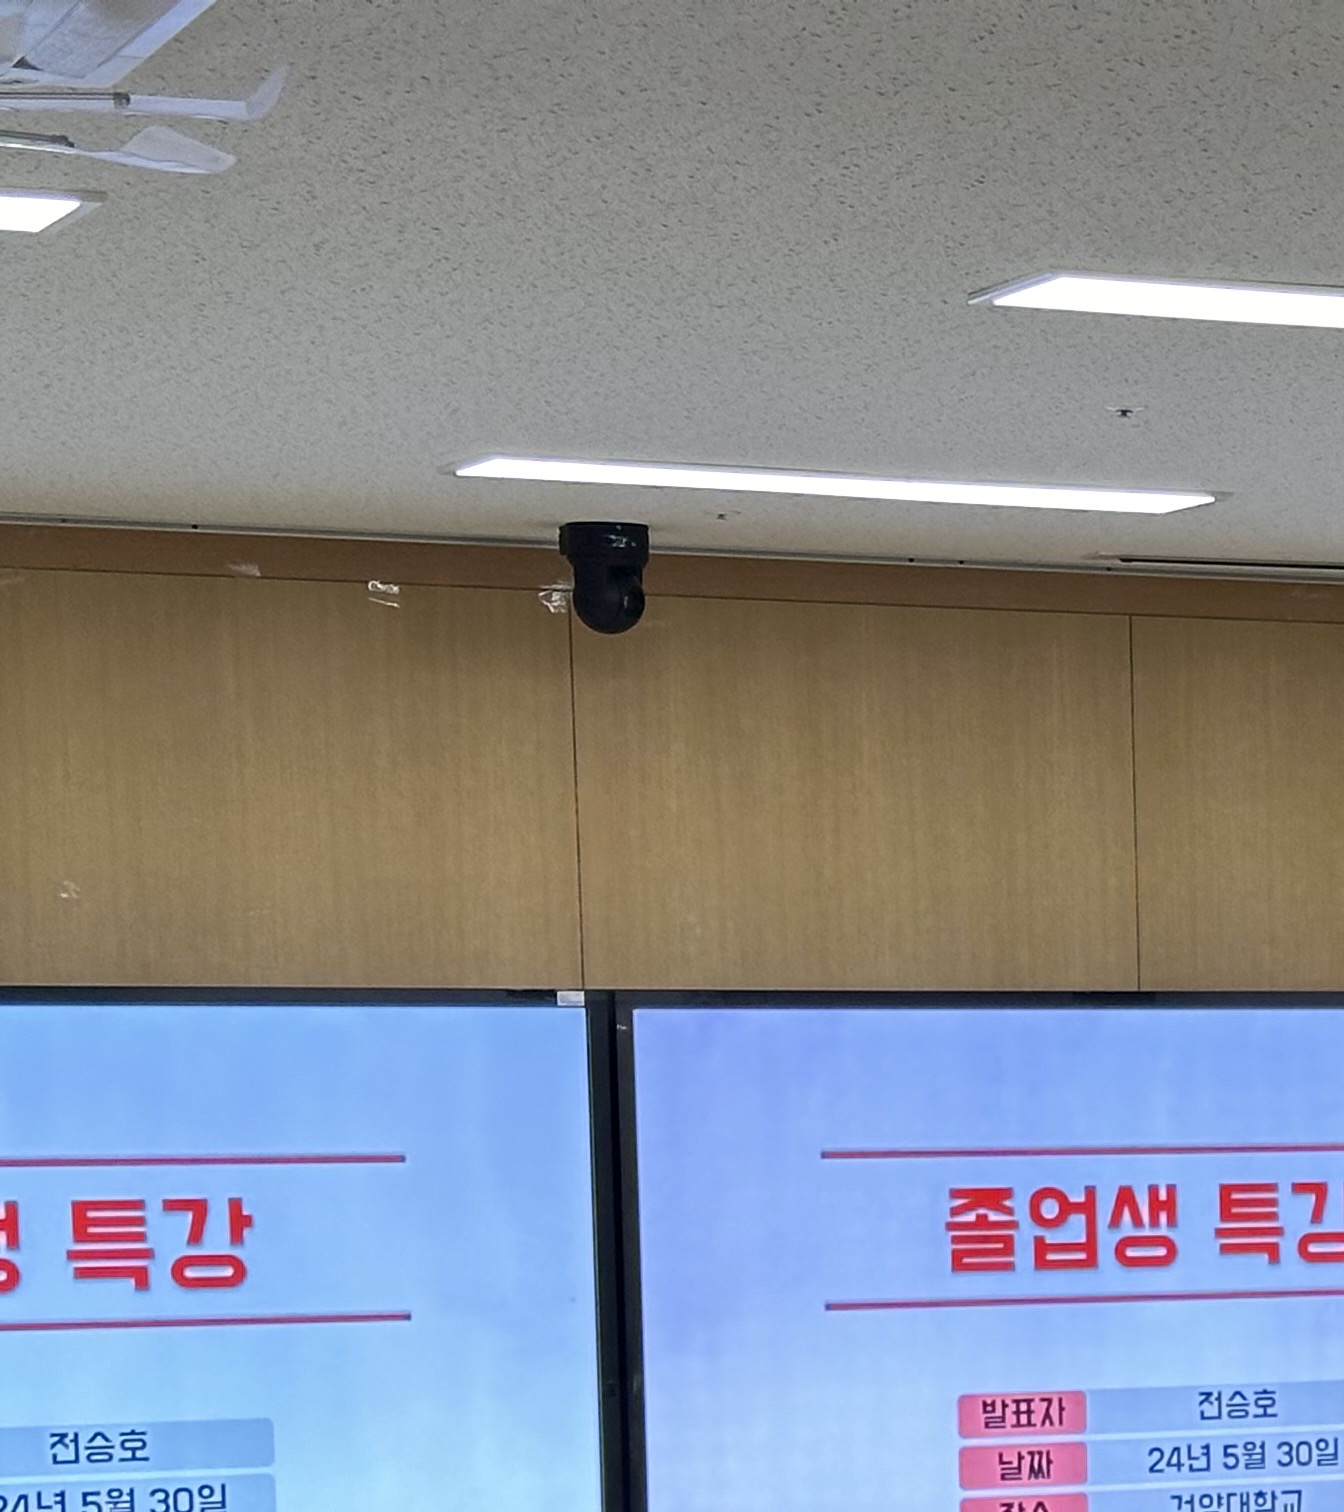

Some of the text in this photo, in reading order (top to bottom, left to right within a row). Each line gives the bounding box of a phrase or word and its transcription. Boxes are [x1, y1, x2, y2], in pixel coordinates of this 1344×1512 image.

[66, 1198, 254, 1290] 특강
[945, 1184, 1178, 1273] 졸업생
[982, 1397, 1066, 1430] 발표자
[1198, 1389, 1279, 1421] 전승호
[50, 1429, 150, 1465] 전승호
[1147, 1437, 1340, 1474] 24년 5월 30일
[998, 1450, 1053, 1482] 날짜
